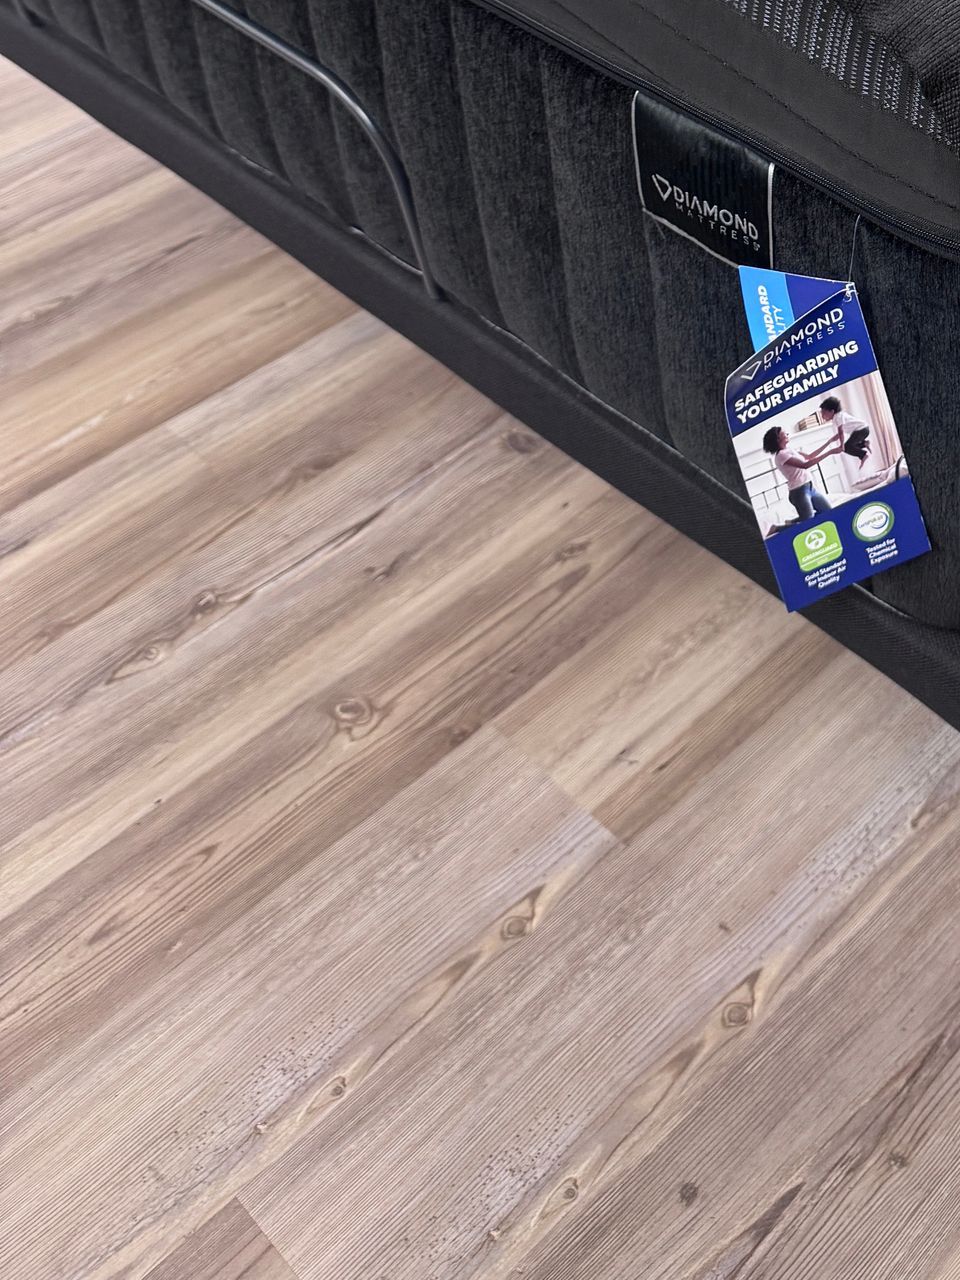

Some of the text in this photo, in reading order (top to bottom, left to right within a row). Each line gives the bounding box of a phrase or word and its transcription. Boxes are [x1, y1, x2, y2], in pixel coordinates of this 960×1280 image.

[673, 185, 759, 241] DIAMOND
[763, 308, 844, 364] DIAMOND
[764, 321, 846, 371] MATTRESS
[734, 340, 859, 412] SAFEGUARDING
[737, 364, 839, 425] YOUR FAMILY
[865, 540, 887, 554] Tested
[868, 543, 897, 558] Chemical
[870, 550, 899, 565] Exposure
[804, 570, 820, 582] Gold
[819, 558, 847, 575] Standard
[817, 570, 837, 583] Indoor
[818, 575, 840, 589] Quality
